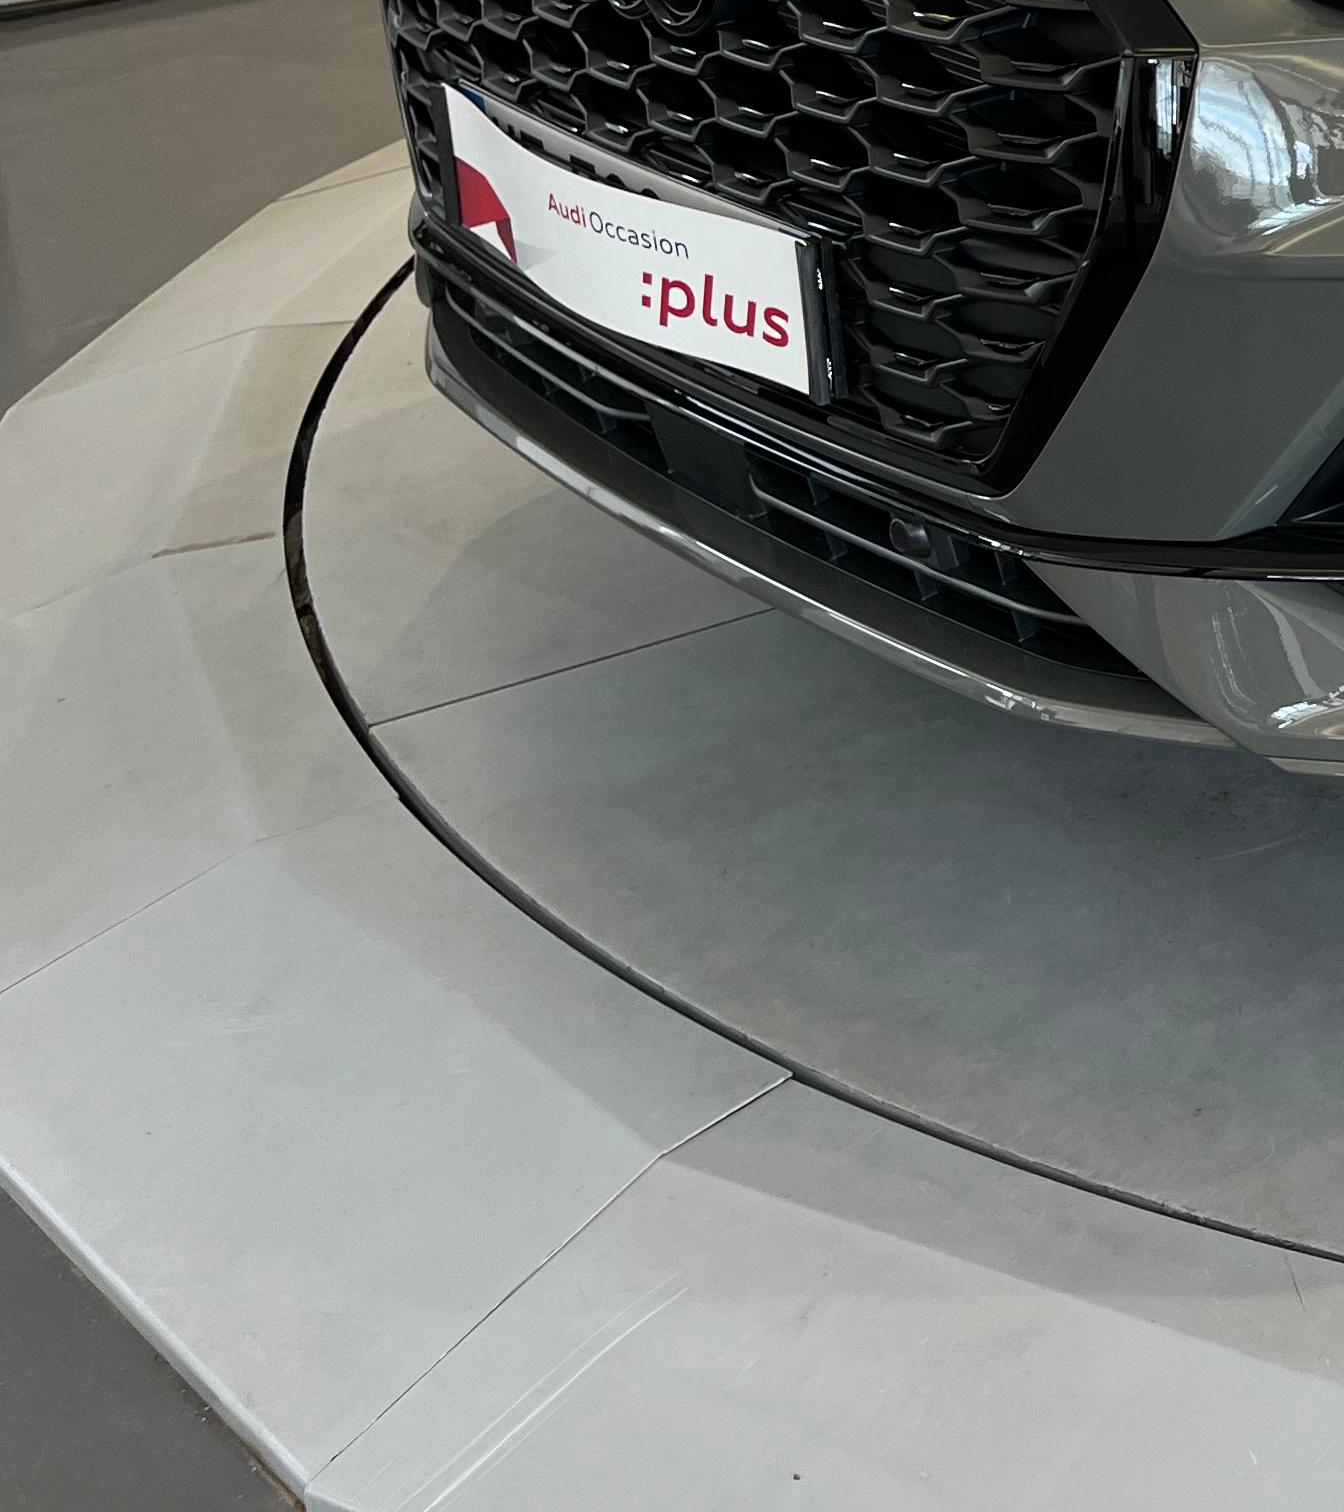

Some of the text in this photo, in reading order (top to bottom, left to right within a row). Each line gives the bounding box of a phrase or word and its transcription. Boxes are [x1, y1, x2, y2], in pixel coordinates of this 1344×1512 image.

[549, 193, 689, 260] Audi Occasion
[641, 271, 790, 348] :plus
